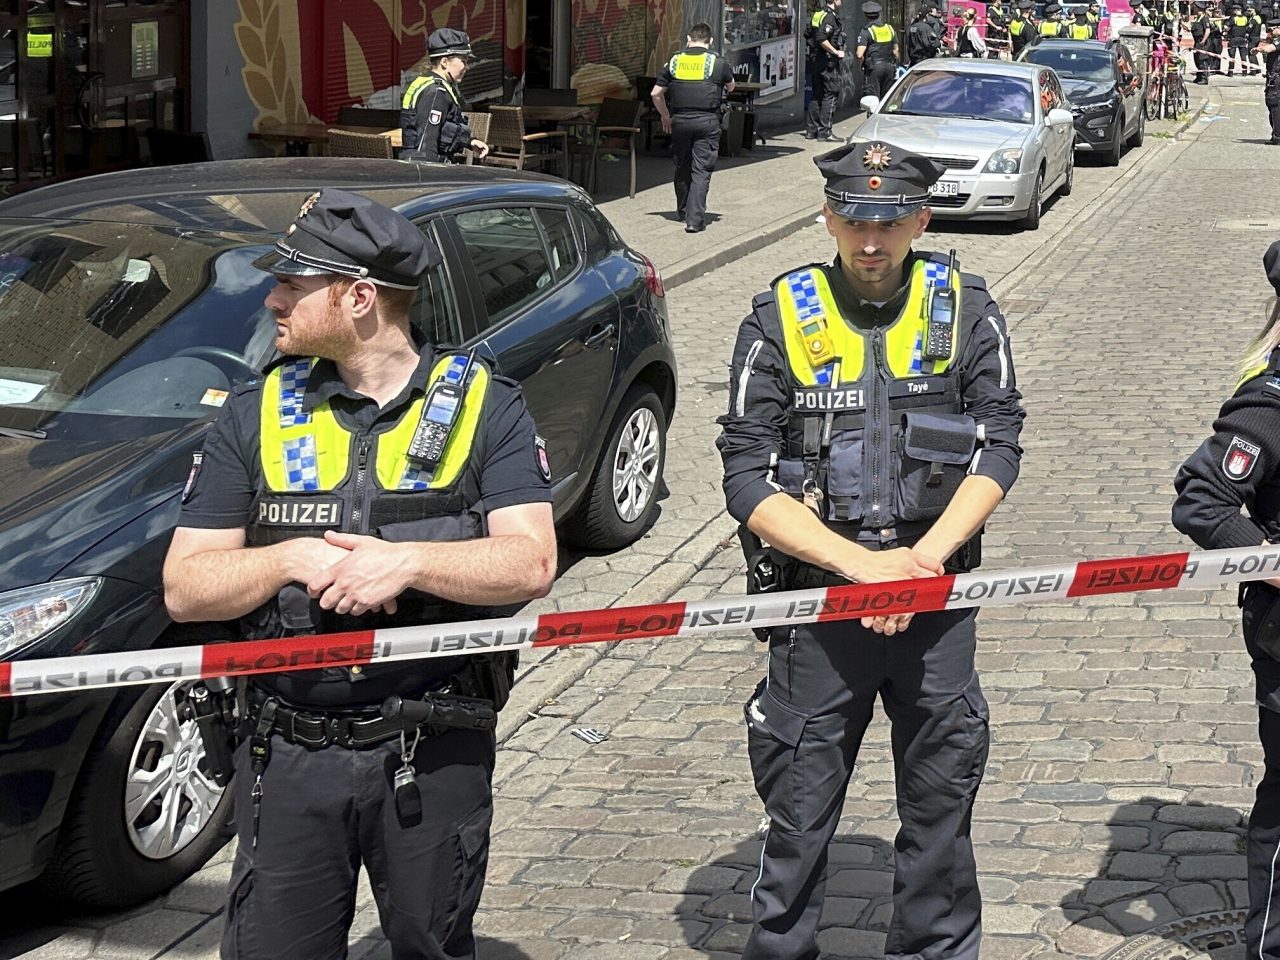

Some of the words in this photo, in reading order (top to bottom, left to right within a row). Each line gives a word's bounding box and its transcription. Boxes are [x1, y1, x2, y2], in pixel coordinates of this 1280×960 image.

[678, 62, 703, 72] POLIZEI
[908, 382, 929, 393] Tayé
[795, 389, 864, 409] POLIZEI
[1232, 439, 1260, 457] POLIZEI
[259, 502, 337, 523] POLIZEI
